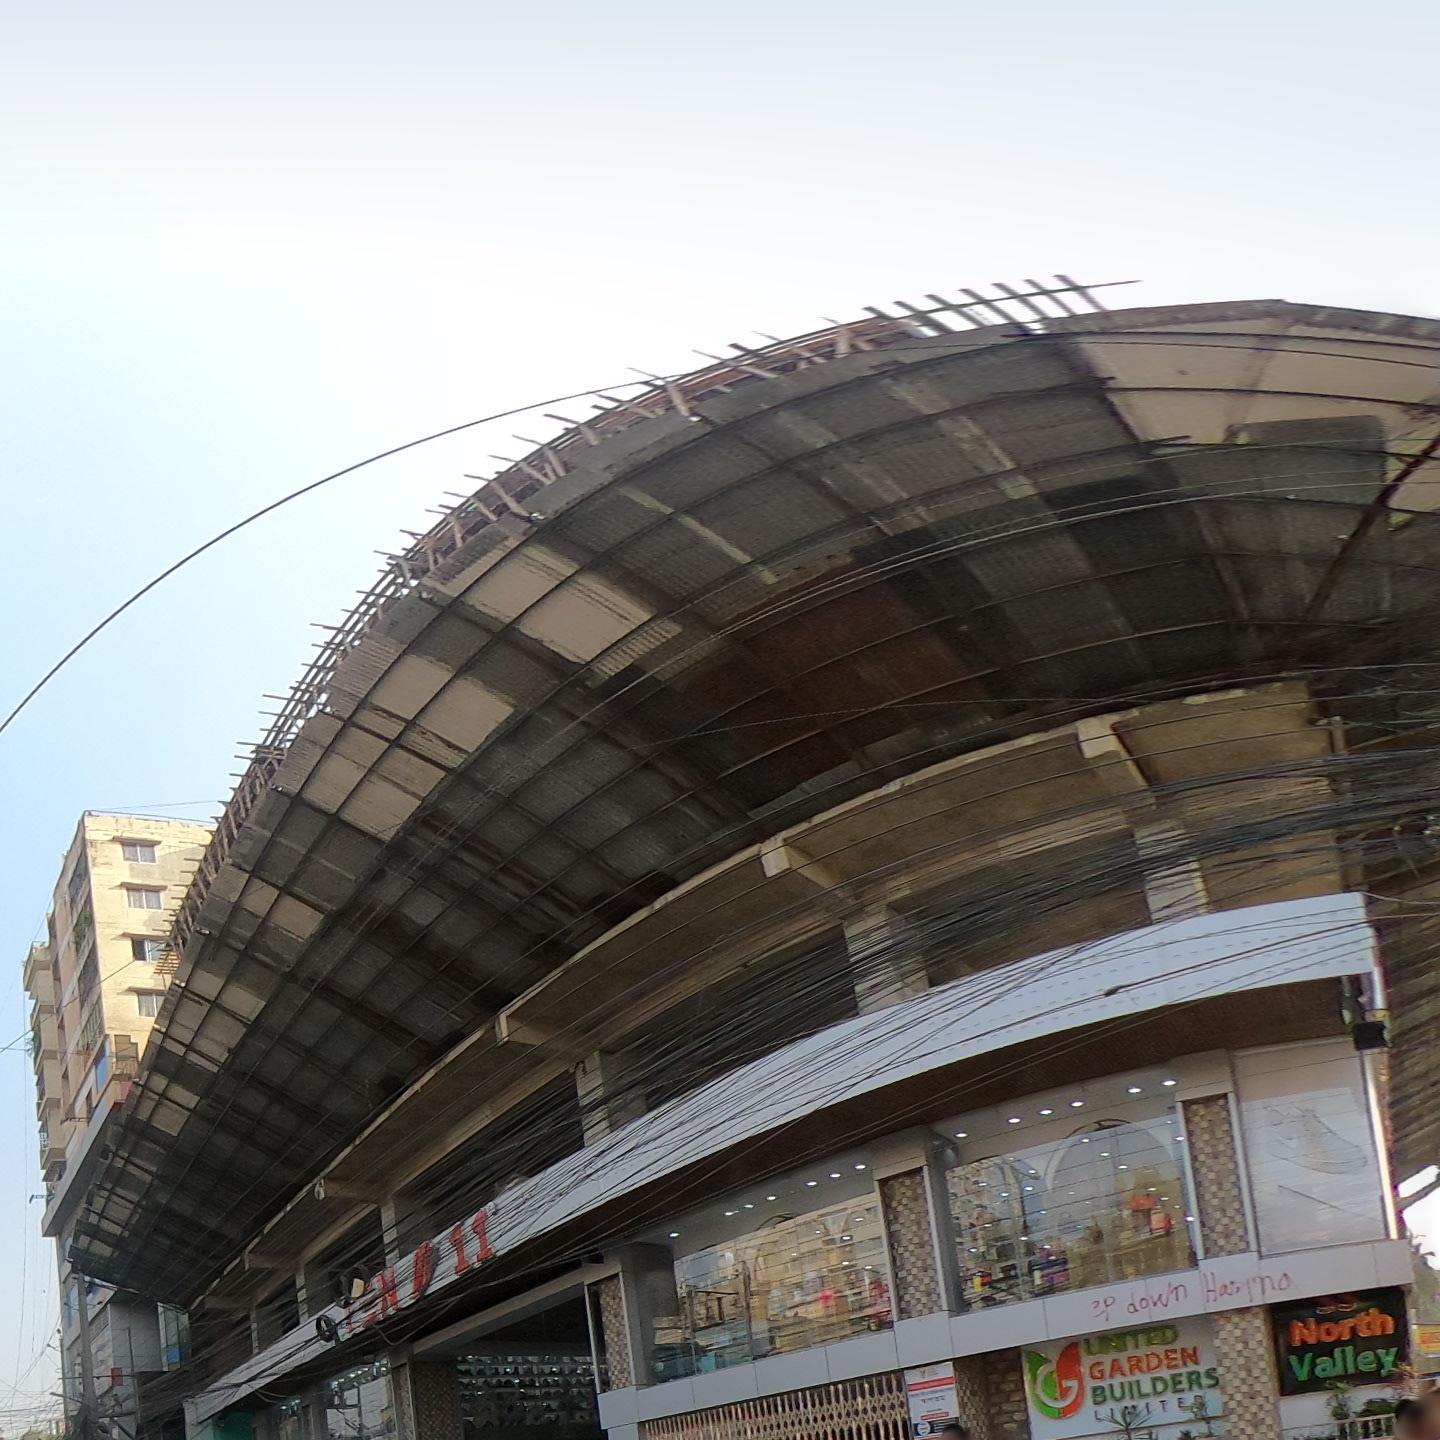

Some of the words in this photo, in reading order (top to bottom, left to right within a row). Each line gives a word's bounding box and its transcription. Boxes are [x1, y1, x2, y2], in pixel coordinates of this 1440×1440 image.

[1127, 1282, 1188, 1314] down
[1083, 1324, 1178, 1357] UNITED
[1288, 1307, 1395, 1347] North
[1089, 1346, 1200, 1381] GARDEN
[1287, 1345, 1398, 1381] Valley
[1091, 1367, 1220, 1405] BUILDERS
